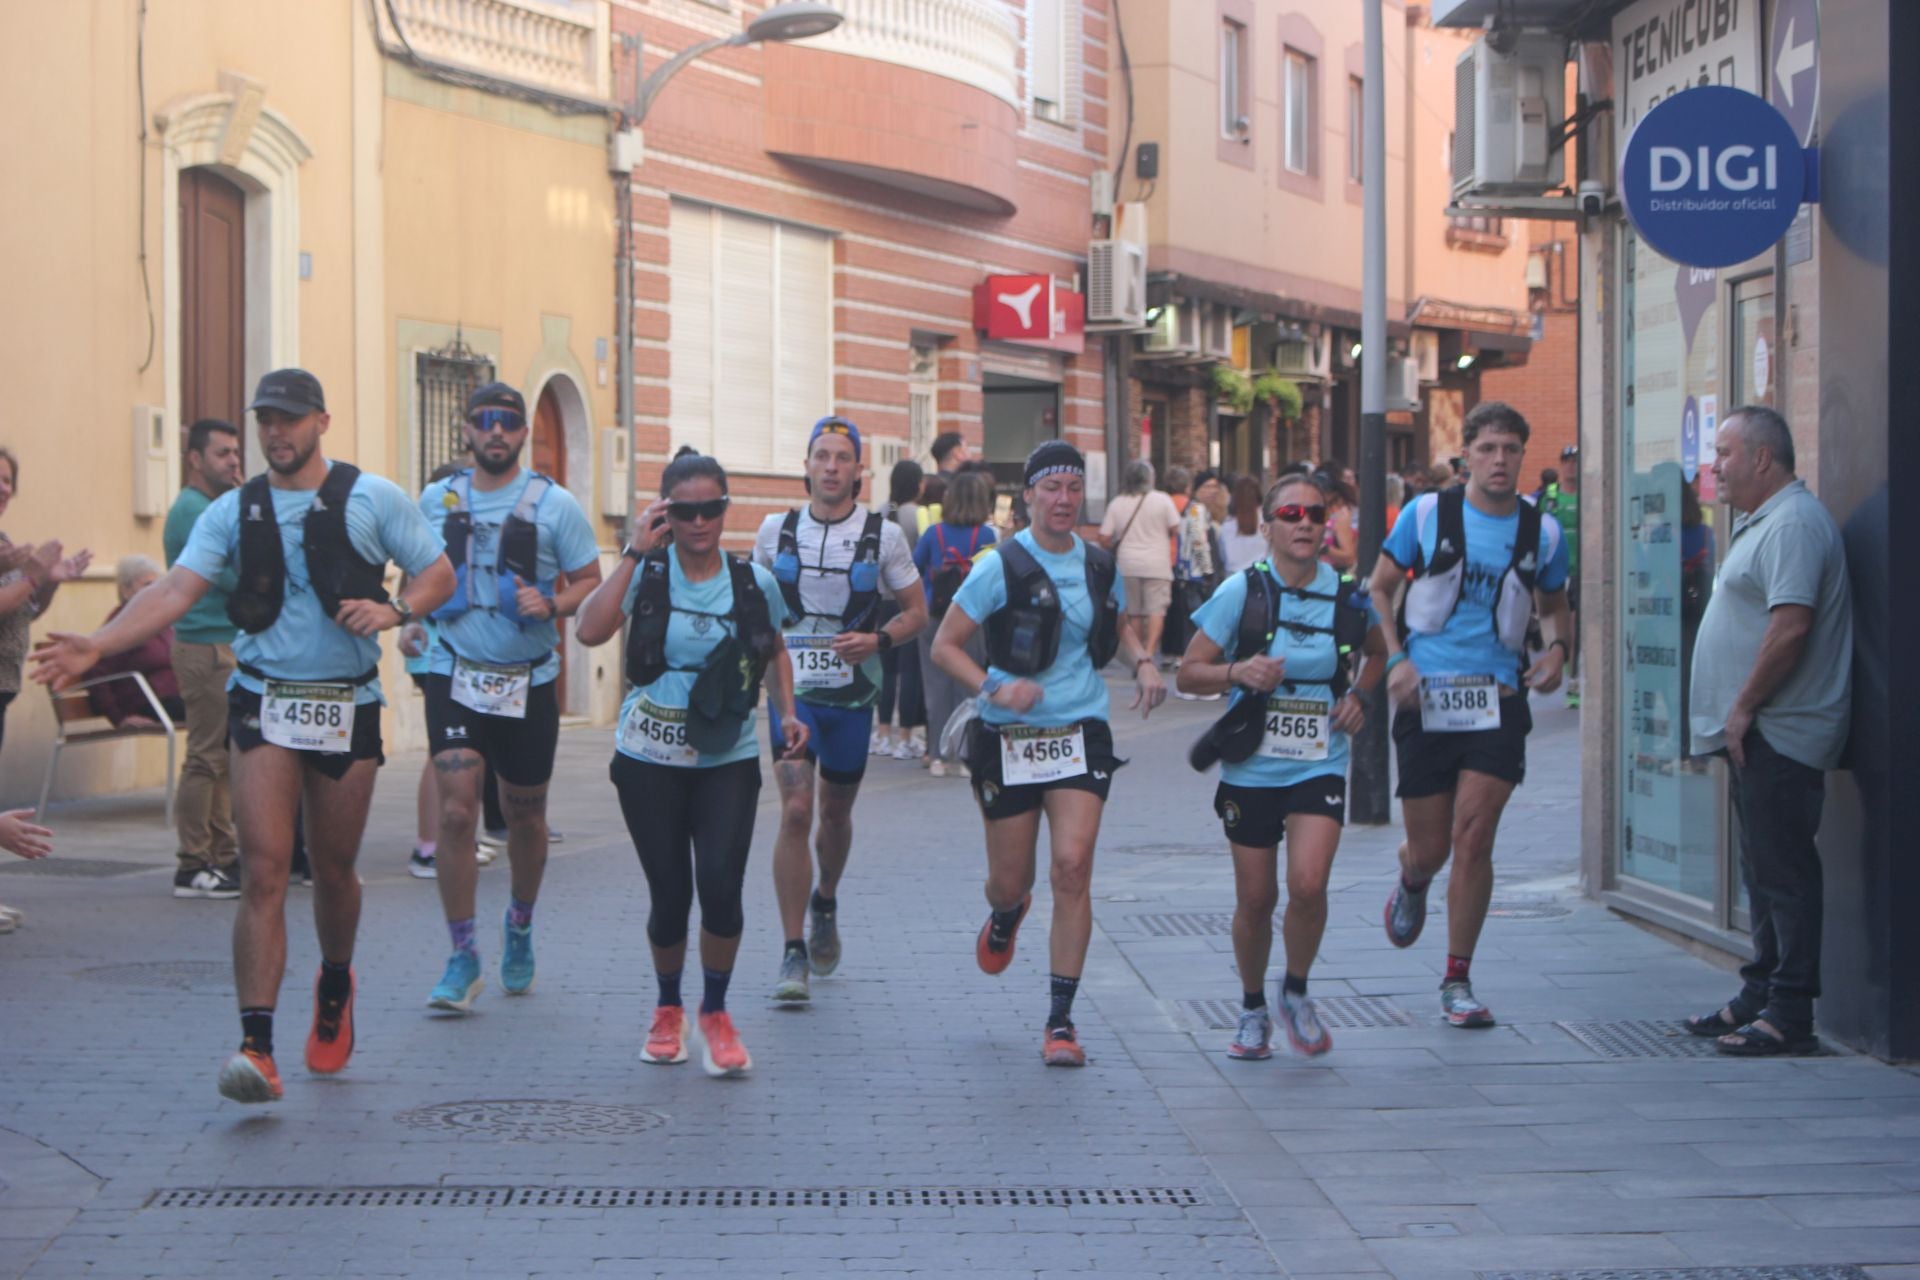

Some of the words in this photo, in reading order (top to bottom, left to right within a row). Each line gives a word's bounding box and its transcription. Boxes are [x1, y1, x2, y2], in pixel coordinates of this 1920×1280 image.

[1650, 145, 1777, 191] DIGI
[1650, 199, 1729, 212] Distribuidor
[1732, 198, 1777, 211] oficial
[797, 651, 842, 670] 1354
[1440, 689, 1488, 711] 3588
[284, 702, 341, 727] 4568
[640, 717, 687, 747] 4569
[1266, 715, 1318, 738] 4565
[1023, 738, 1073, 762] 4566
